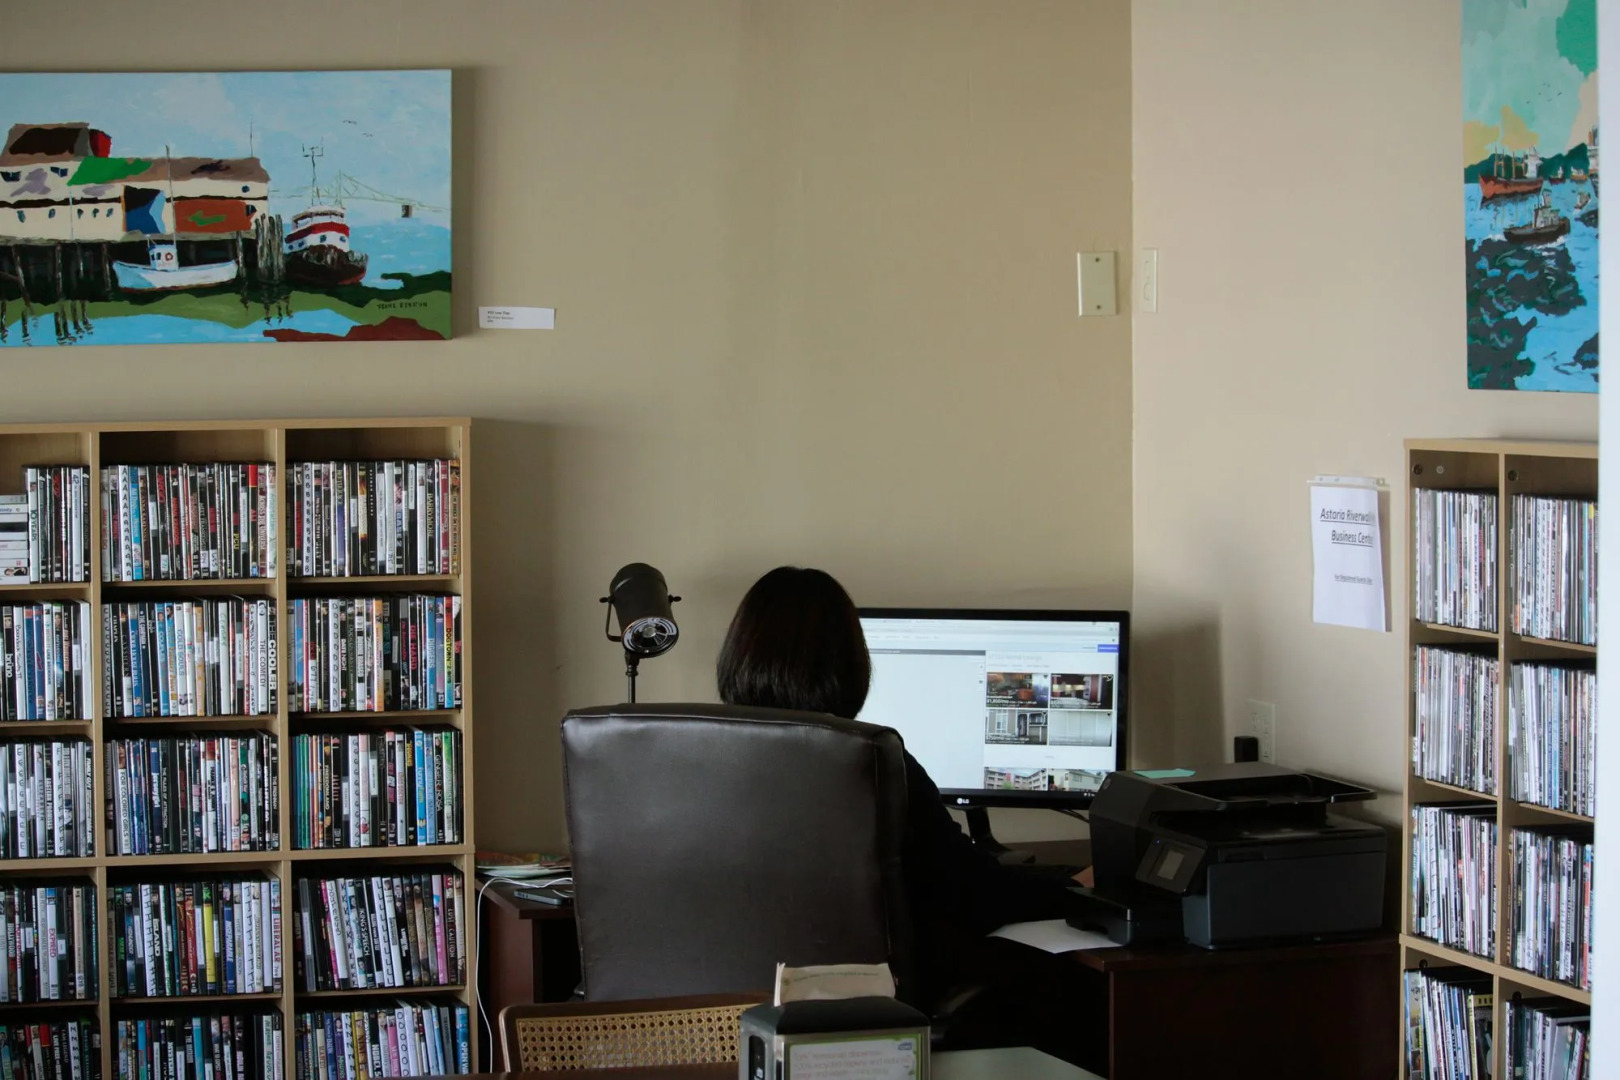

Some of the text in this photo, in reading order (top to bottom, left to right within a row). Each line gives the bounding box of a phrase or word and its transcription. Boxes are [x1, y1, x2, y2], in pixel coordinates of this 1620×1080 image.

[1320, 508, 1345, 520] Astoria
[1331, 529, 1357, 543] Business
[177, 629, 185, 650] COLD
[259, 640, 267, 654] THE
[428, 637, 436, 669] DIGGERS
[6, 653, 14, 678] brüno
[269, 639, 277, 690] COOLER
[120, 786, 128, 818] COLORED
[49, 928, 57, 958] EXPIRED
[273, 917, 281, 947] LIBERAL
[361, 932, 370, 956] SPEECH
[448, 928, 457, 958] CAUTION
[371, 1044, 381, 1071] NOBEL
